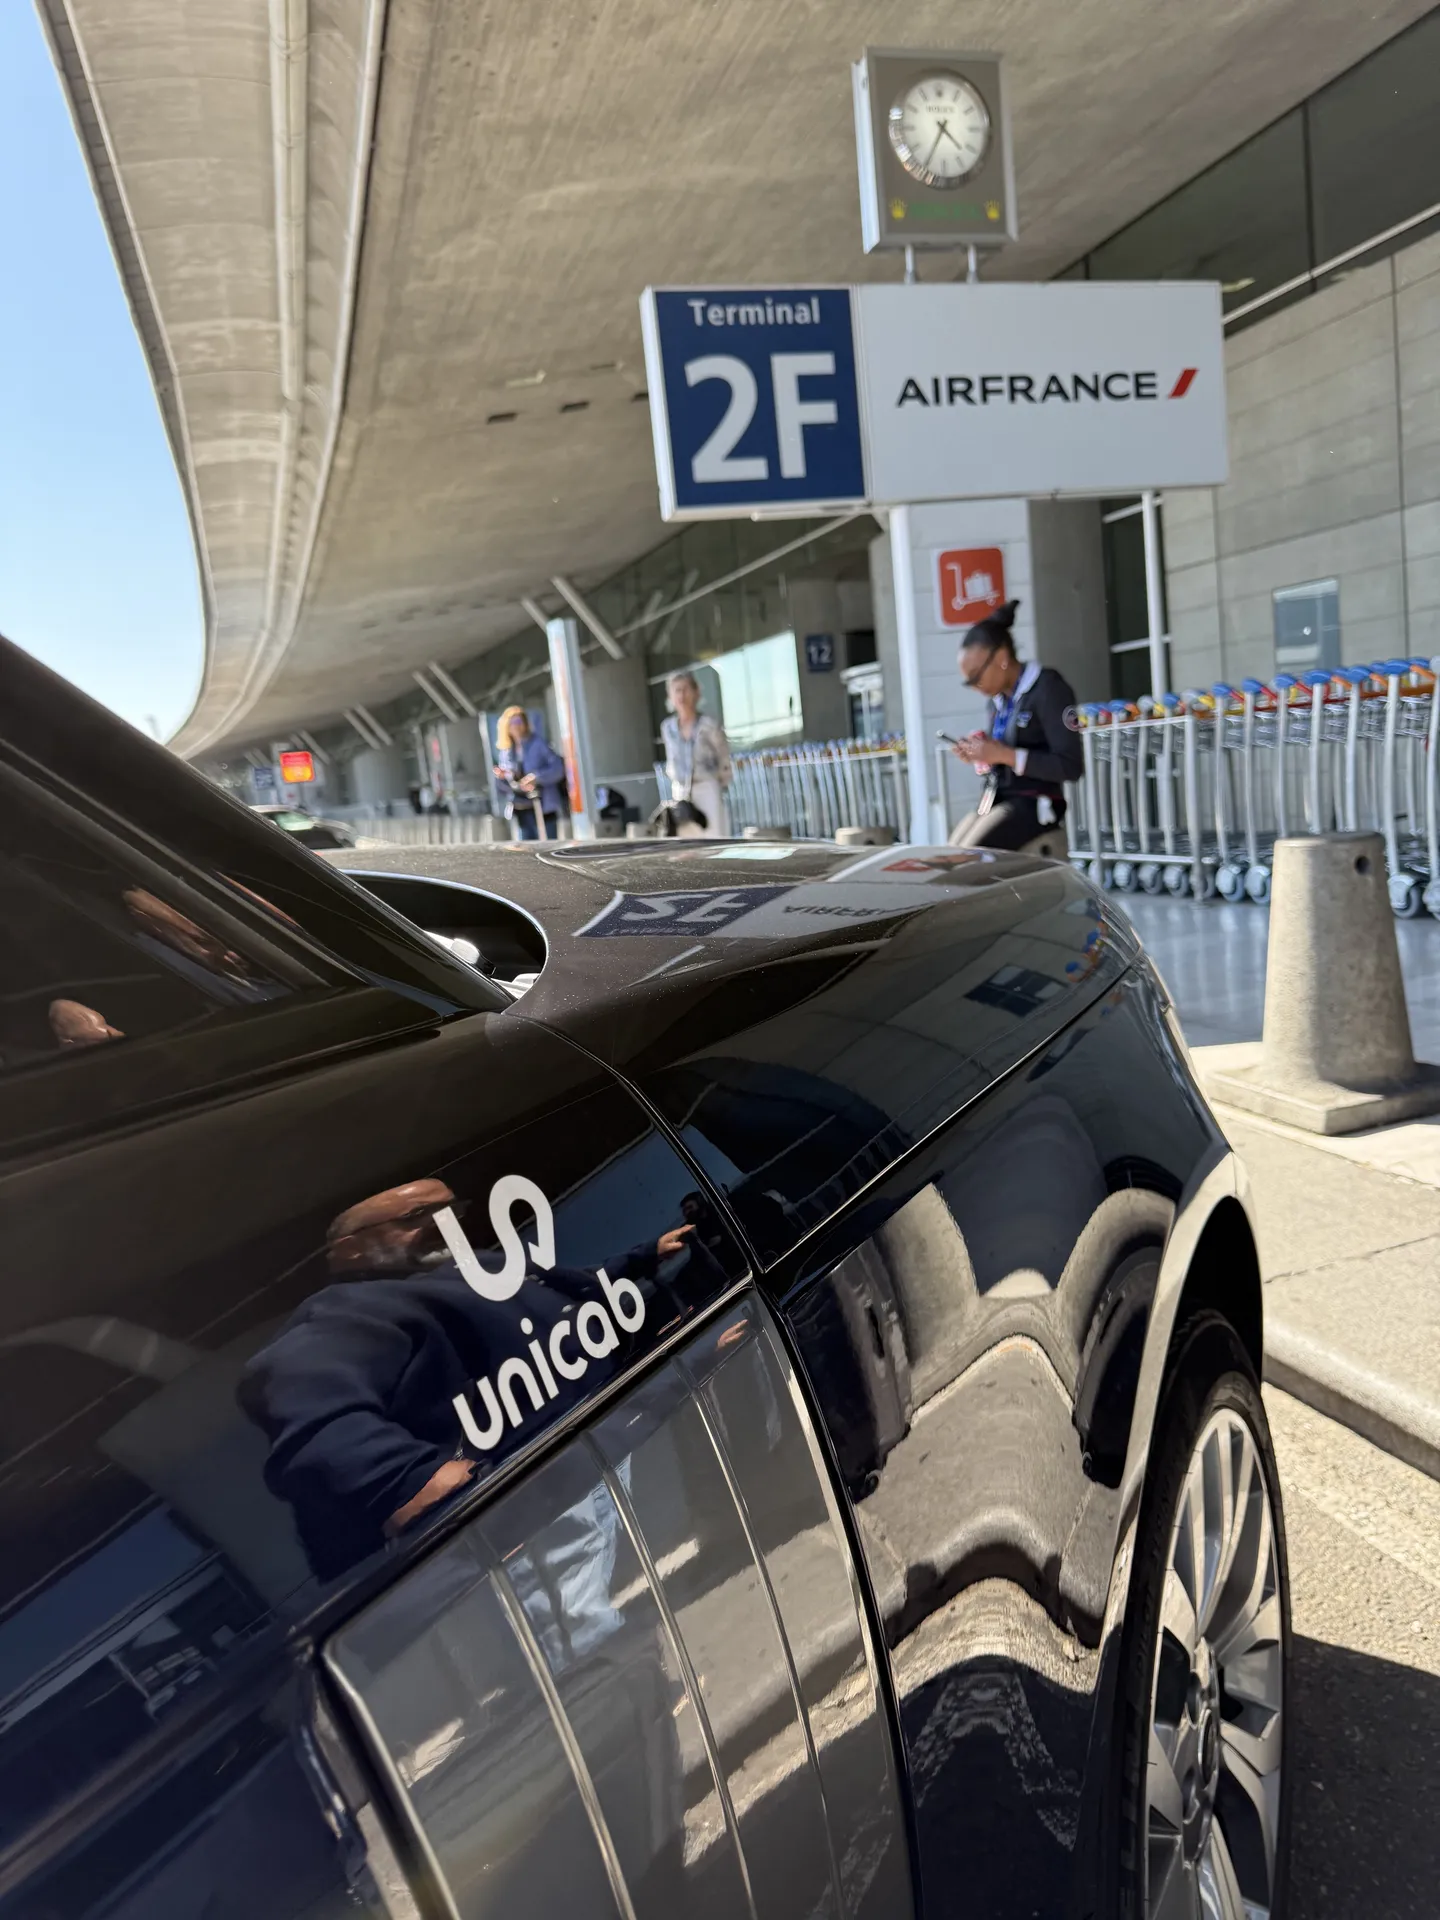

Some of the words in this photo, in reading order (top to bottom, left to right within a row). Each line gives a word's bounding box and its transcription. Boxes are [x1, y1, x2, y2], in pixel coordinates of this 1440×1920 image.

[687, 296, 821, 327] Terminal
[895, 371, 1158, 408] AIRFRANCE
[684, 351, 839, 484] 2F
[808, 643, 832, 665] 12
[452, 1267, 646, 1452] unicab
